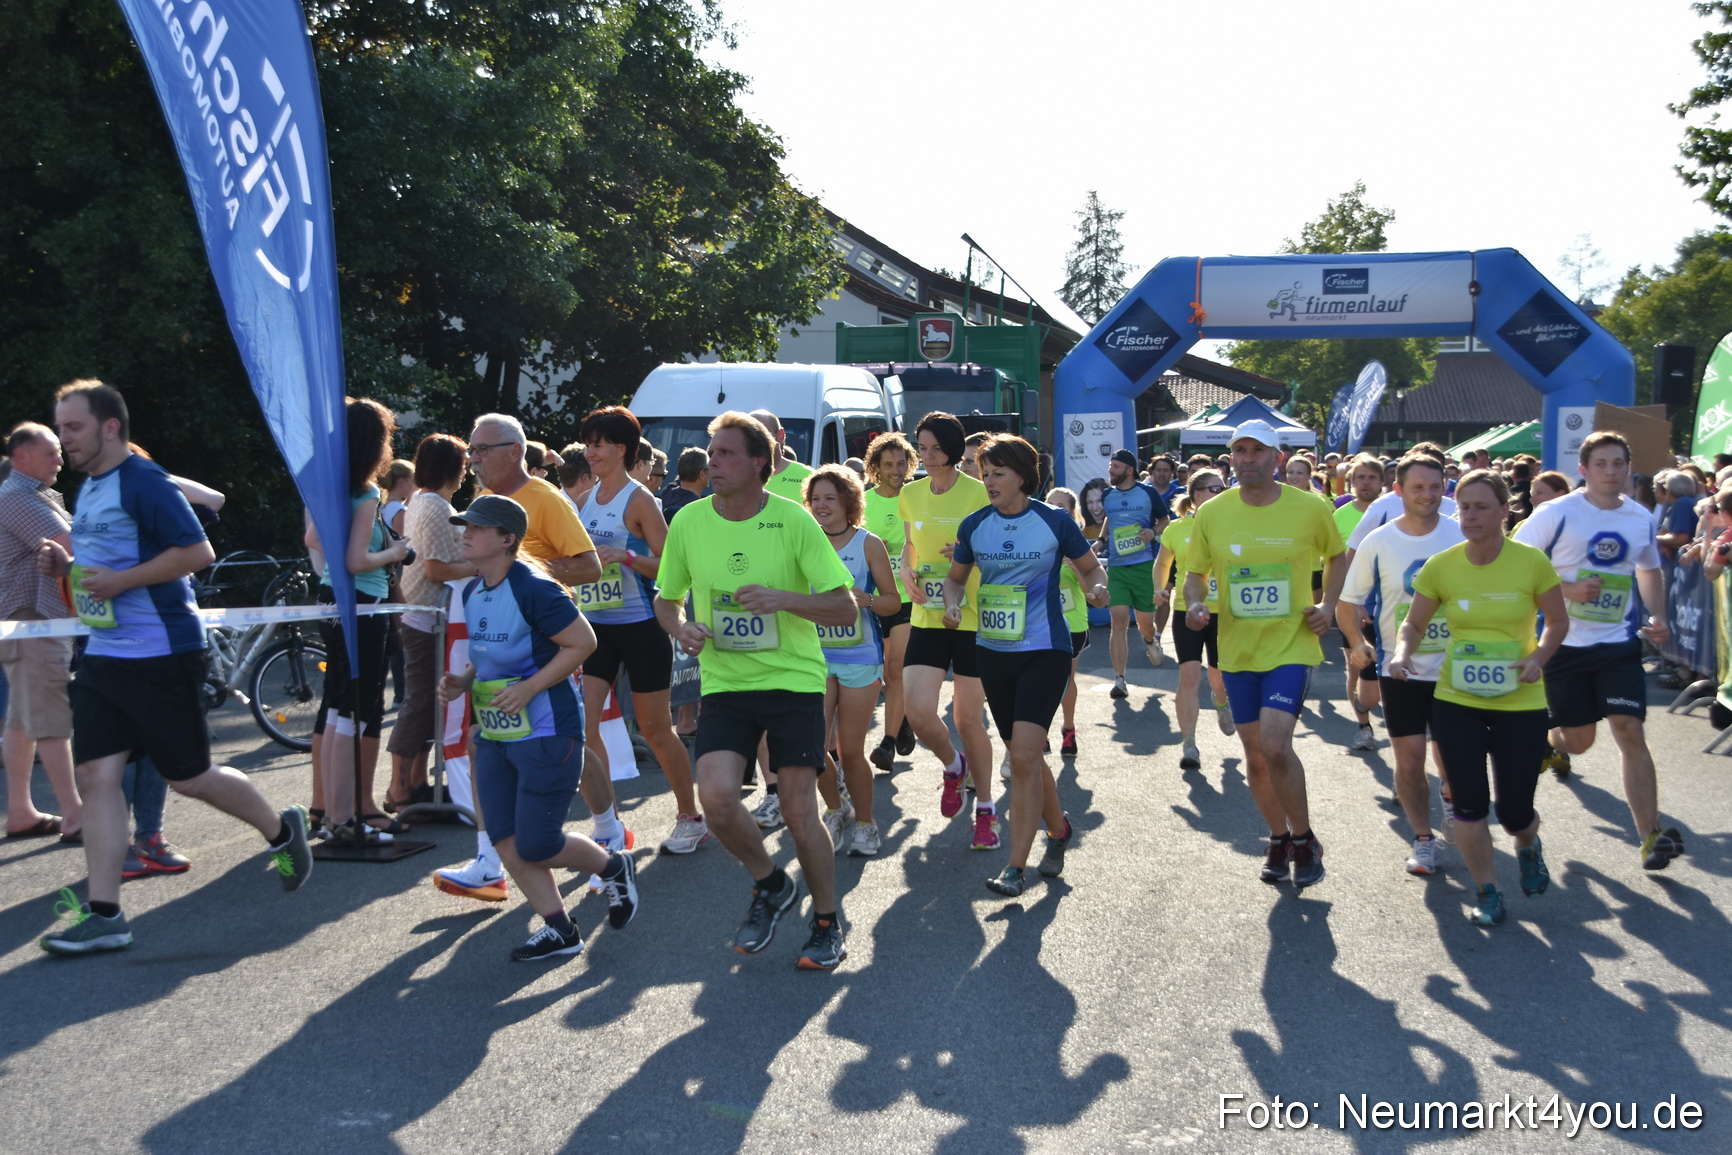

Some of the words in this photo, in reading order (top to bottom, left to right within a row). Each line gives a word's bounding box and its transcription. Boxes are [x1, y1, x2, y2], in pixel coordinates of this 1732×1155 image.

[1332, 277, 1366, 285] Fischer
[1306, 294, 1408, 314] firmenlauf
[1116, 334, 1169, 346] Fischer
[1118, 536, 1142, 550] 6098
[980, 552, 1041, 561] SCHABMÜLLER
[581, 580, 622, 604] 5194
[1240, 586, 1279, 605] 678
[75, 592, 107, 617] 6088
[722, 616, 764, 637] 260
[982, 610, 1016, 630] 6081
[816, 625, 856, 638] 6100
[1463, 665, 1505, 684] 666
[479, 709, 522, 730] 6089
